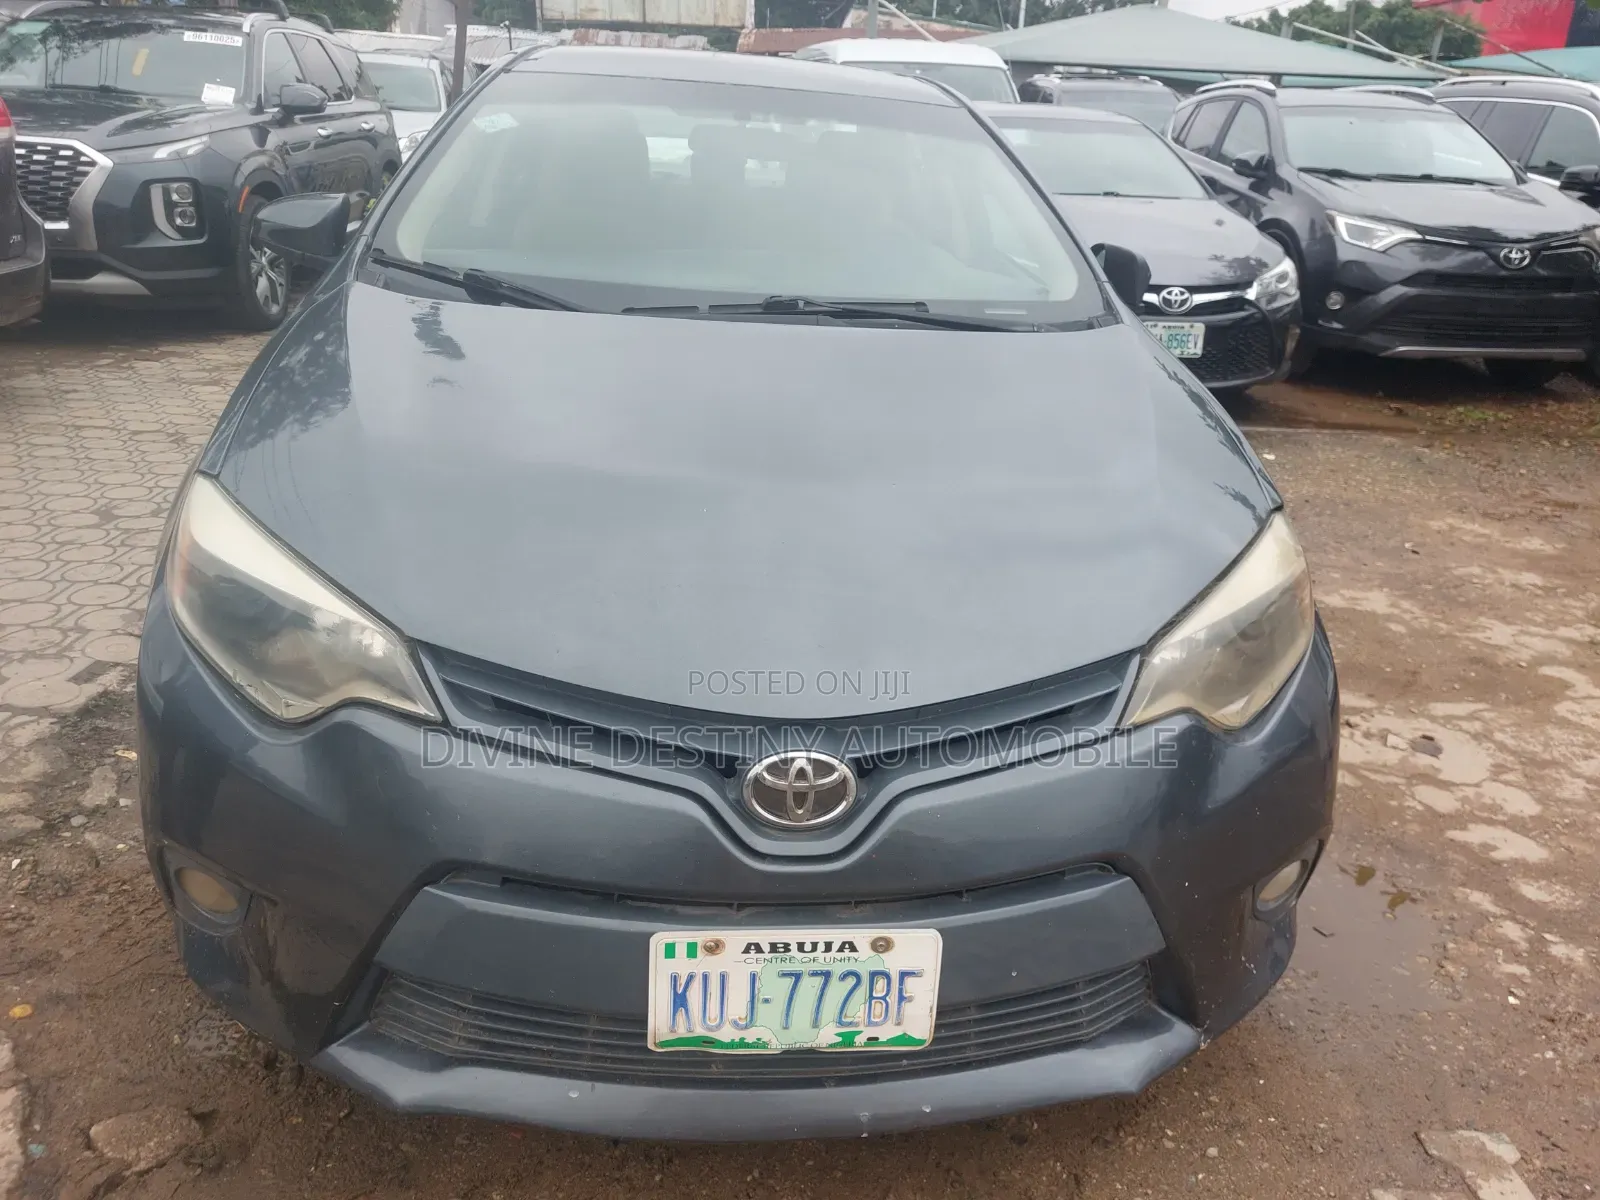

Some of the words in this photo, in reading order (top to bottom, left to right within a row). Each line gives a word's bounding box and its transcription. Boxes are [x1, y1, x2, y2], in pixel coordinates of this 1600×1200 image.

[741, 941, 859, 954] ABUJA
[743, 956, 796, 964] CENTRE
[801, 956, 819, 964] OF
[824, 956, 860, 964] UNITY
[669, 969, 924, 1032] KUJ-772BF
